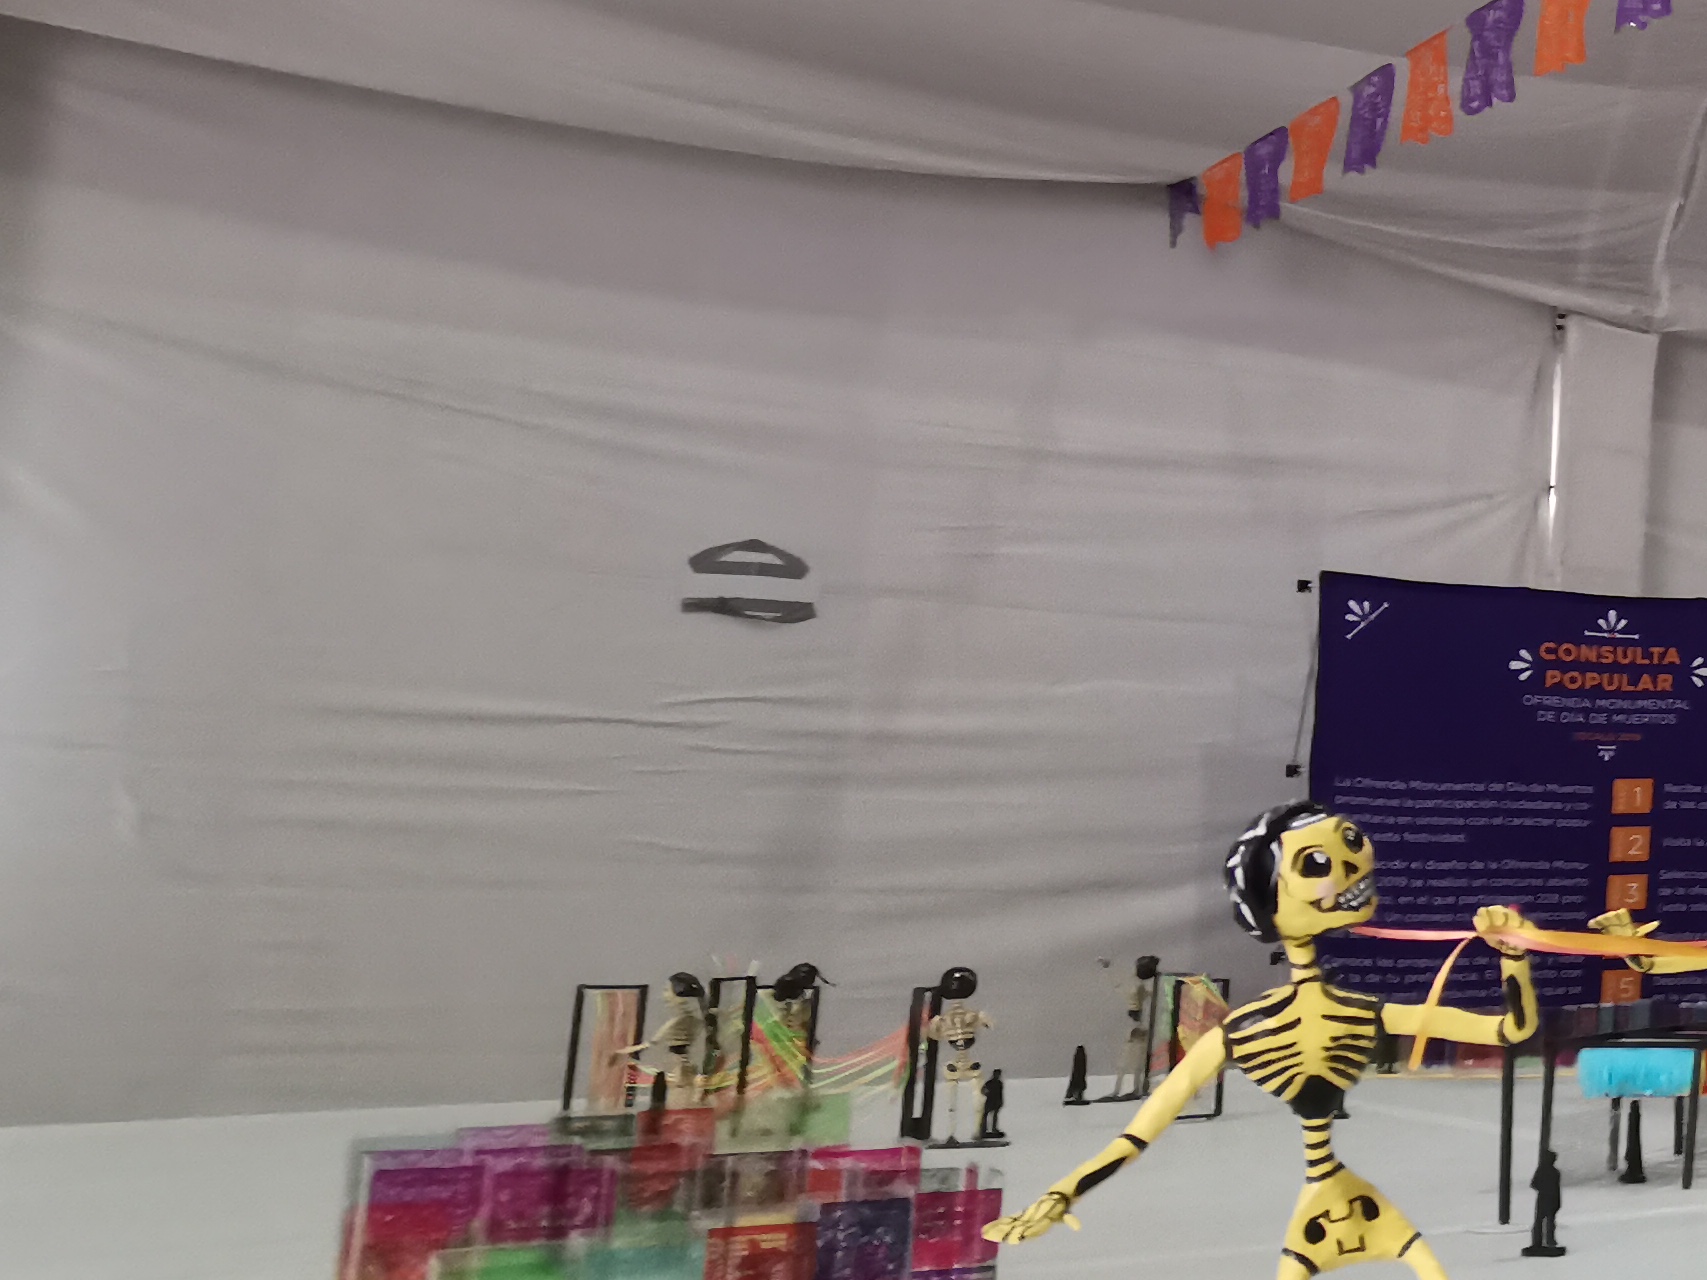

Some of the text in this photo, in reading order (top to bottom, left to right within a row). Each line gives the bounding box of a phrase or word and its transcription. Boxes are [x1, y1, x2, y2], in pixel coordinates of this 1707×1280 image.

[1538, 641, 1681, 665] CONSULTA
[1544, 669, 1674, 692] POPULAR
[1633, 786, 1642, 806] 1
[1627, 834, 1644, 856] 2
[1625, 883, 1639, 904] 3
[1618, 977, 1635, 998] 5
